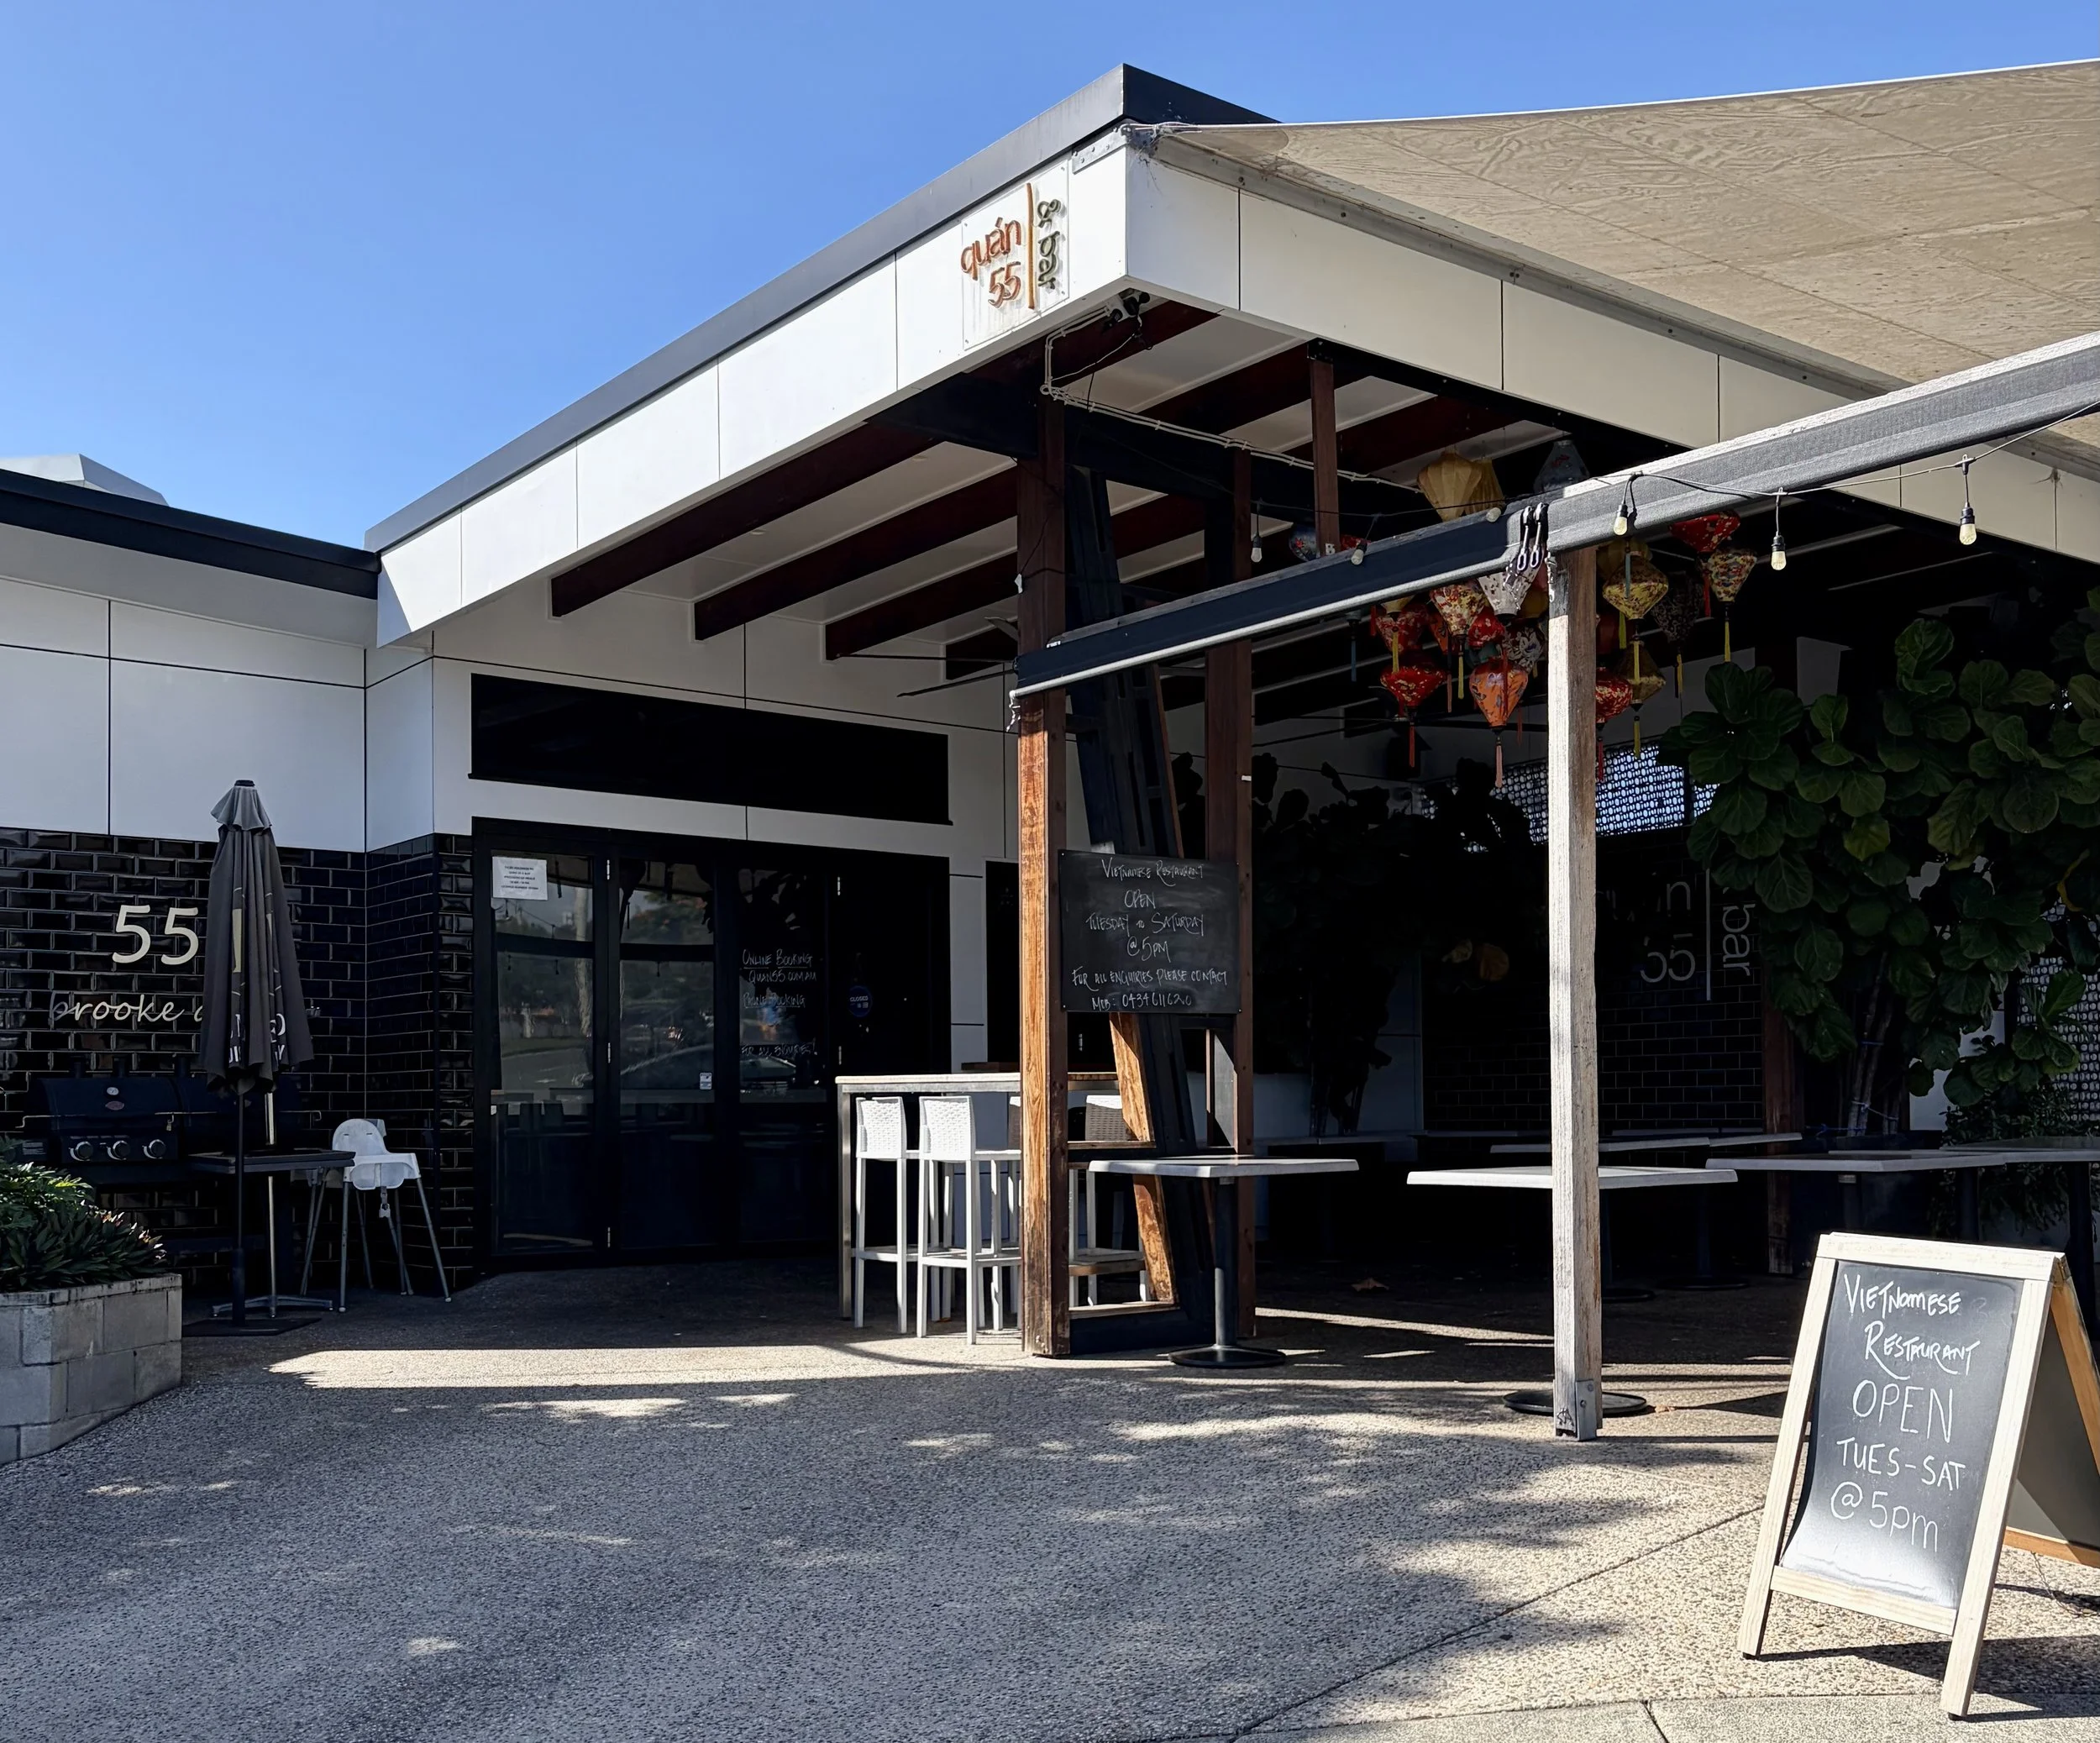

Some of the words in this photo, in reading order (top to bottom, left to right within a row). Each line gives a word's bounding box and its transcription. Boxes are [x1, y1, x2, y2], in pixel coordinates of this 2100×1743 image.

[1037, 198, 1062, 228] &
[961, 217, 1022, 281] quán
[1038, 231, 1061, 290] bar
[988, 260, 1022, 308] 55
[1085, 911, 1131, 937] TUESDAY
[1151, 912, 1205, 937] SATURDAY
[1124, 889, 1156, 909] OPEN
[112, 904, 199, 965] 55
[1721, 902, 1756, 978] bar
[1072, 966, 1100, 992] FOR
[1190, 968, 1228, 986] CONTACT
[50, 991, 185, 1022] brooke
[1864, 1320, 1981, 1380] RESTAURANT
[1851, 1379, 1954, 1444] OPEN
